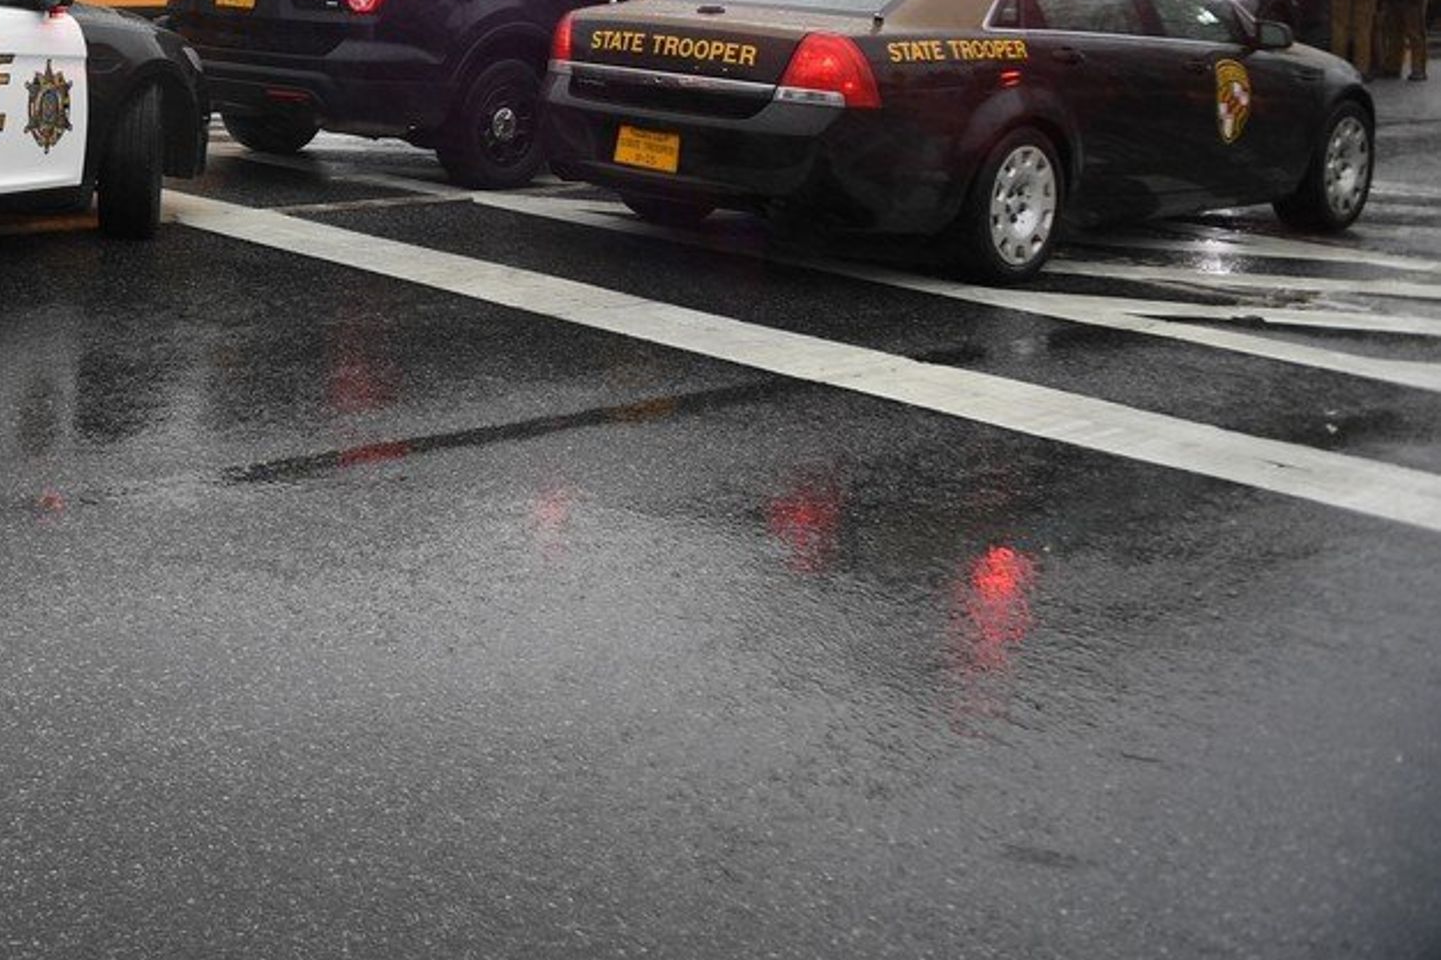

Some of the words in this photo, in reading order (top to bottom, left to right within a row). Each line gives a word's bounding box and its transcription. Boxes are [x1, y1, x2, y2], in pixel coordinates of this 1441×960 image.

[591, 30, 646, 52] STATE
[653, 34, 757, 66] TROOPER
[887, 41, 945, 62] STATE
[947, 39, 1028, 60] TROOPER
